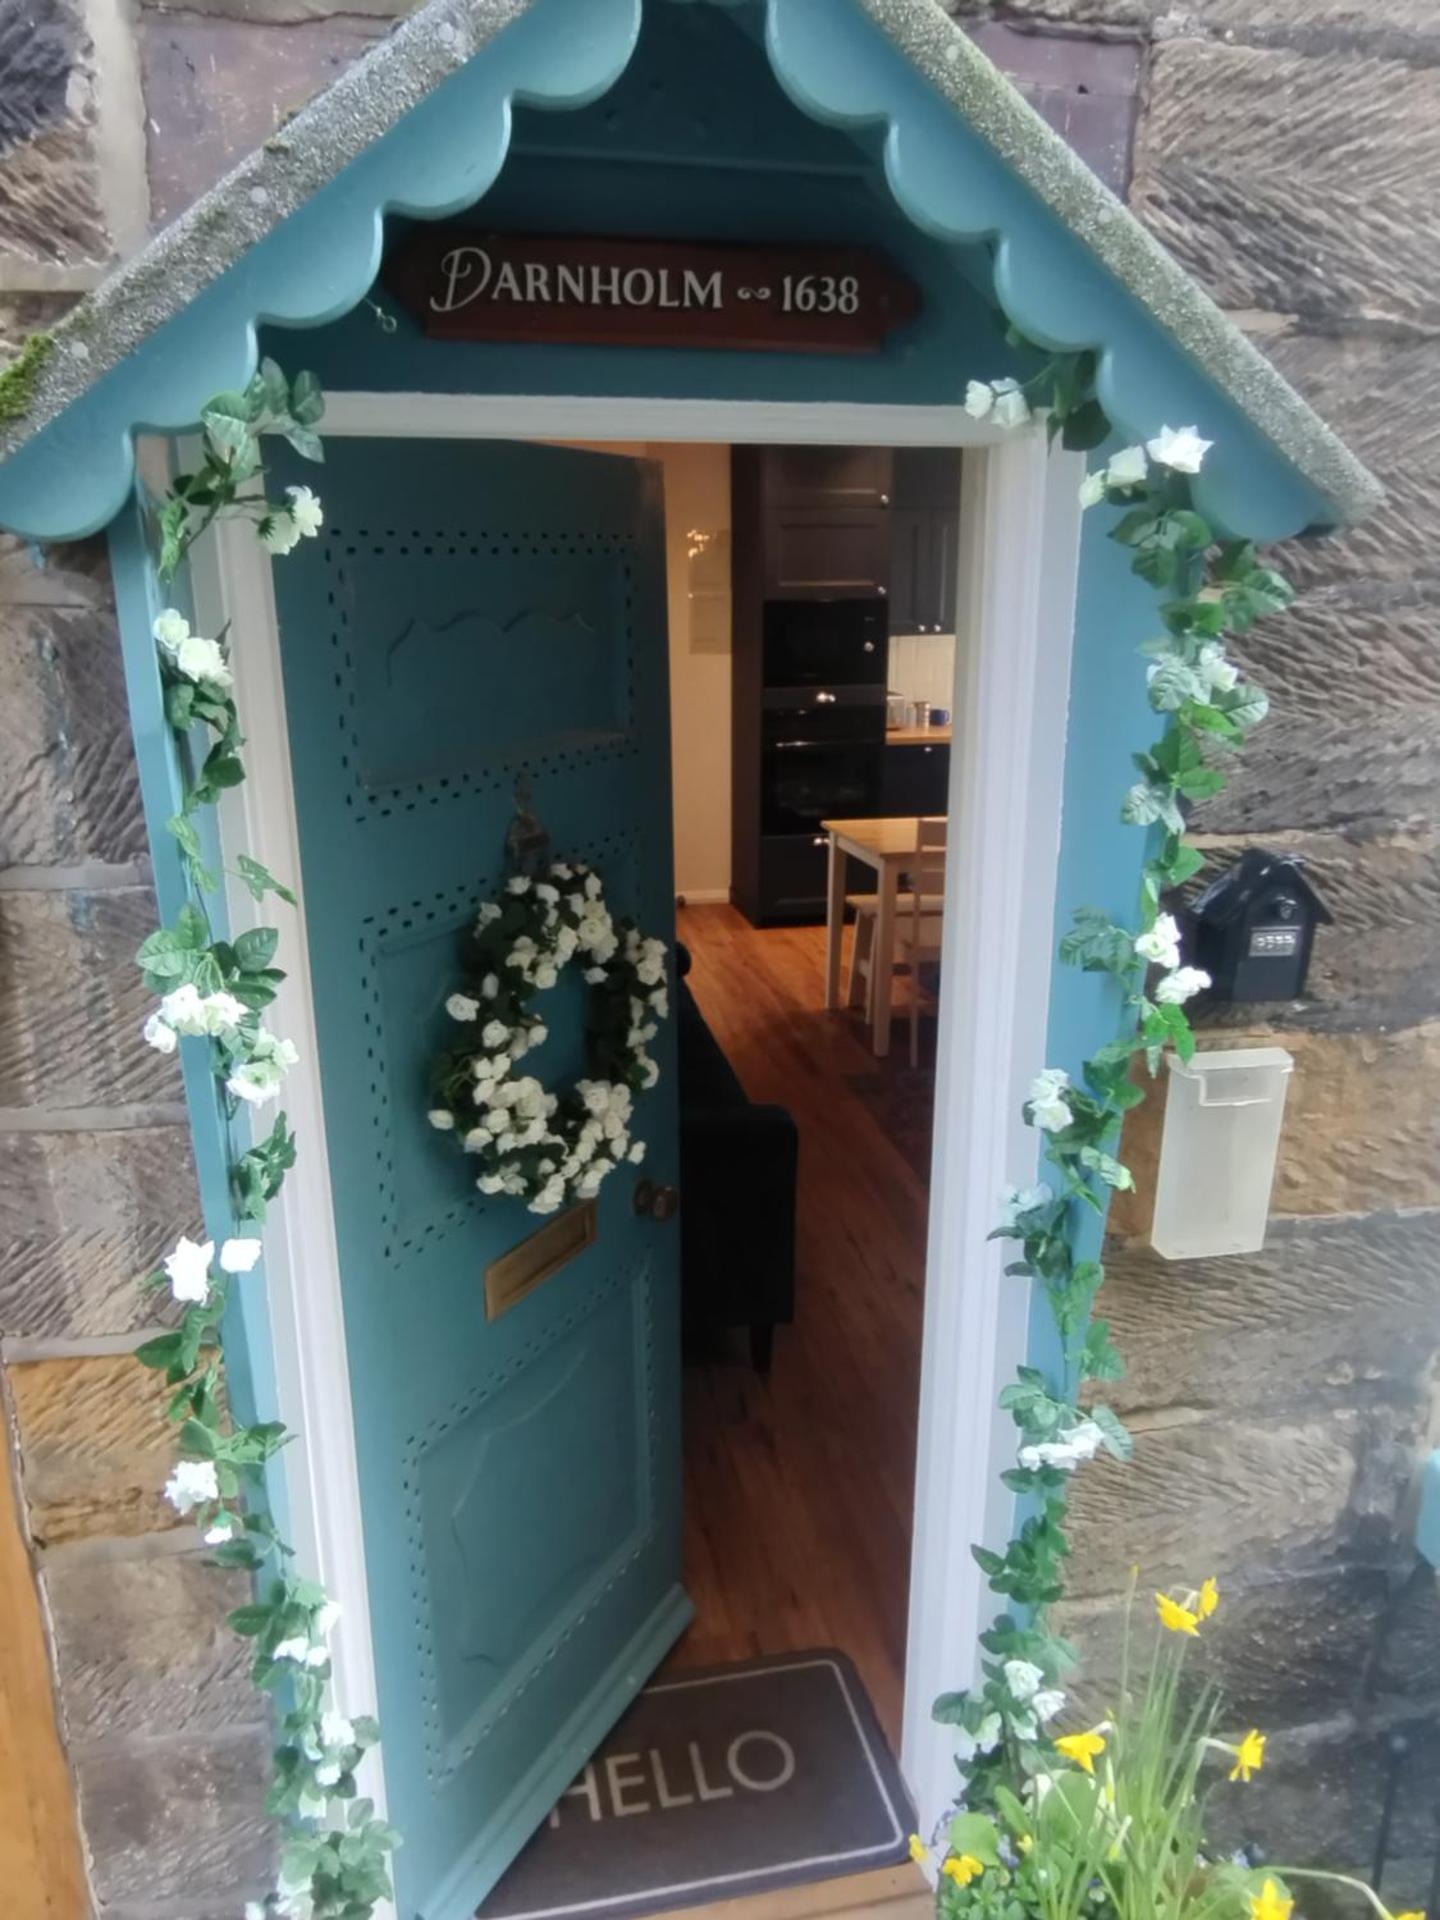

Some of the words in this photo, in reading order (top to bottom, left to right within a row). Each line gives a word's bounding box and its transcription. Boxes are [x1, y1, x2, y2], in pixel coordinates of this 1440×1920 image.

[429, 246, 724, 313] DARNHOLM
[781, 276, 860, 314] 1638
[548, 1730, 796, 1829] HELLO
